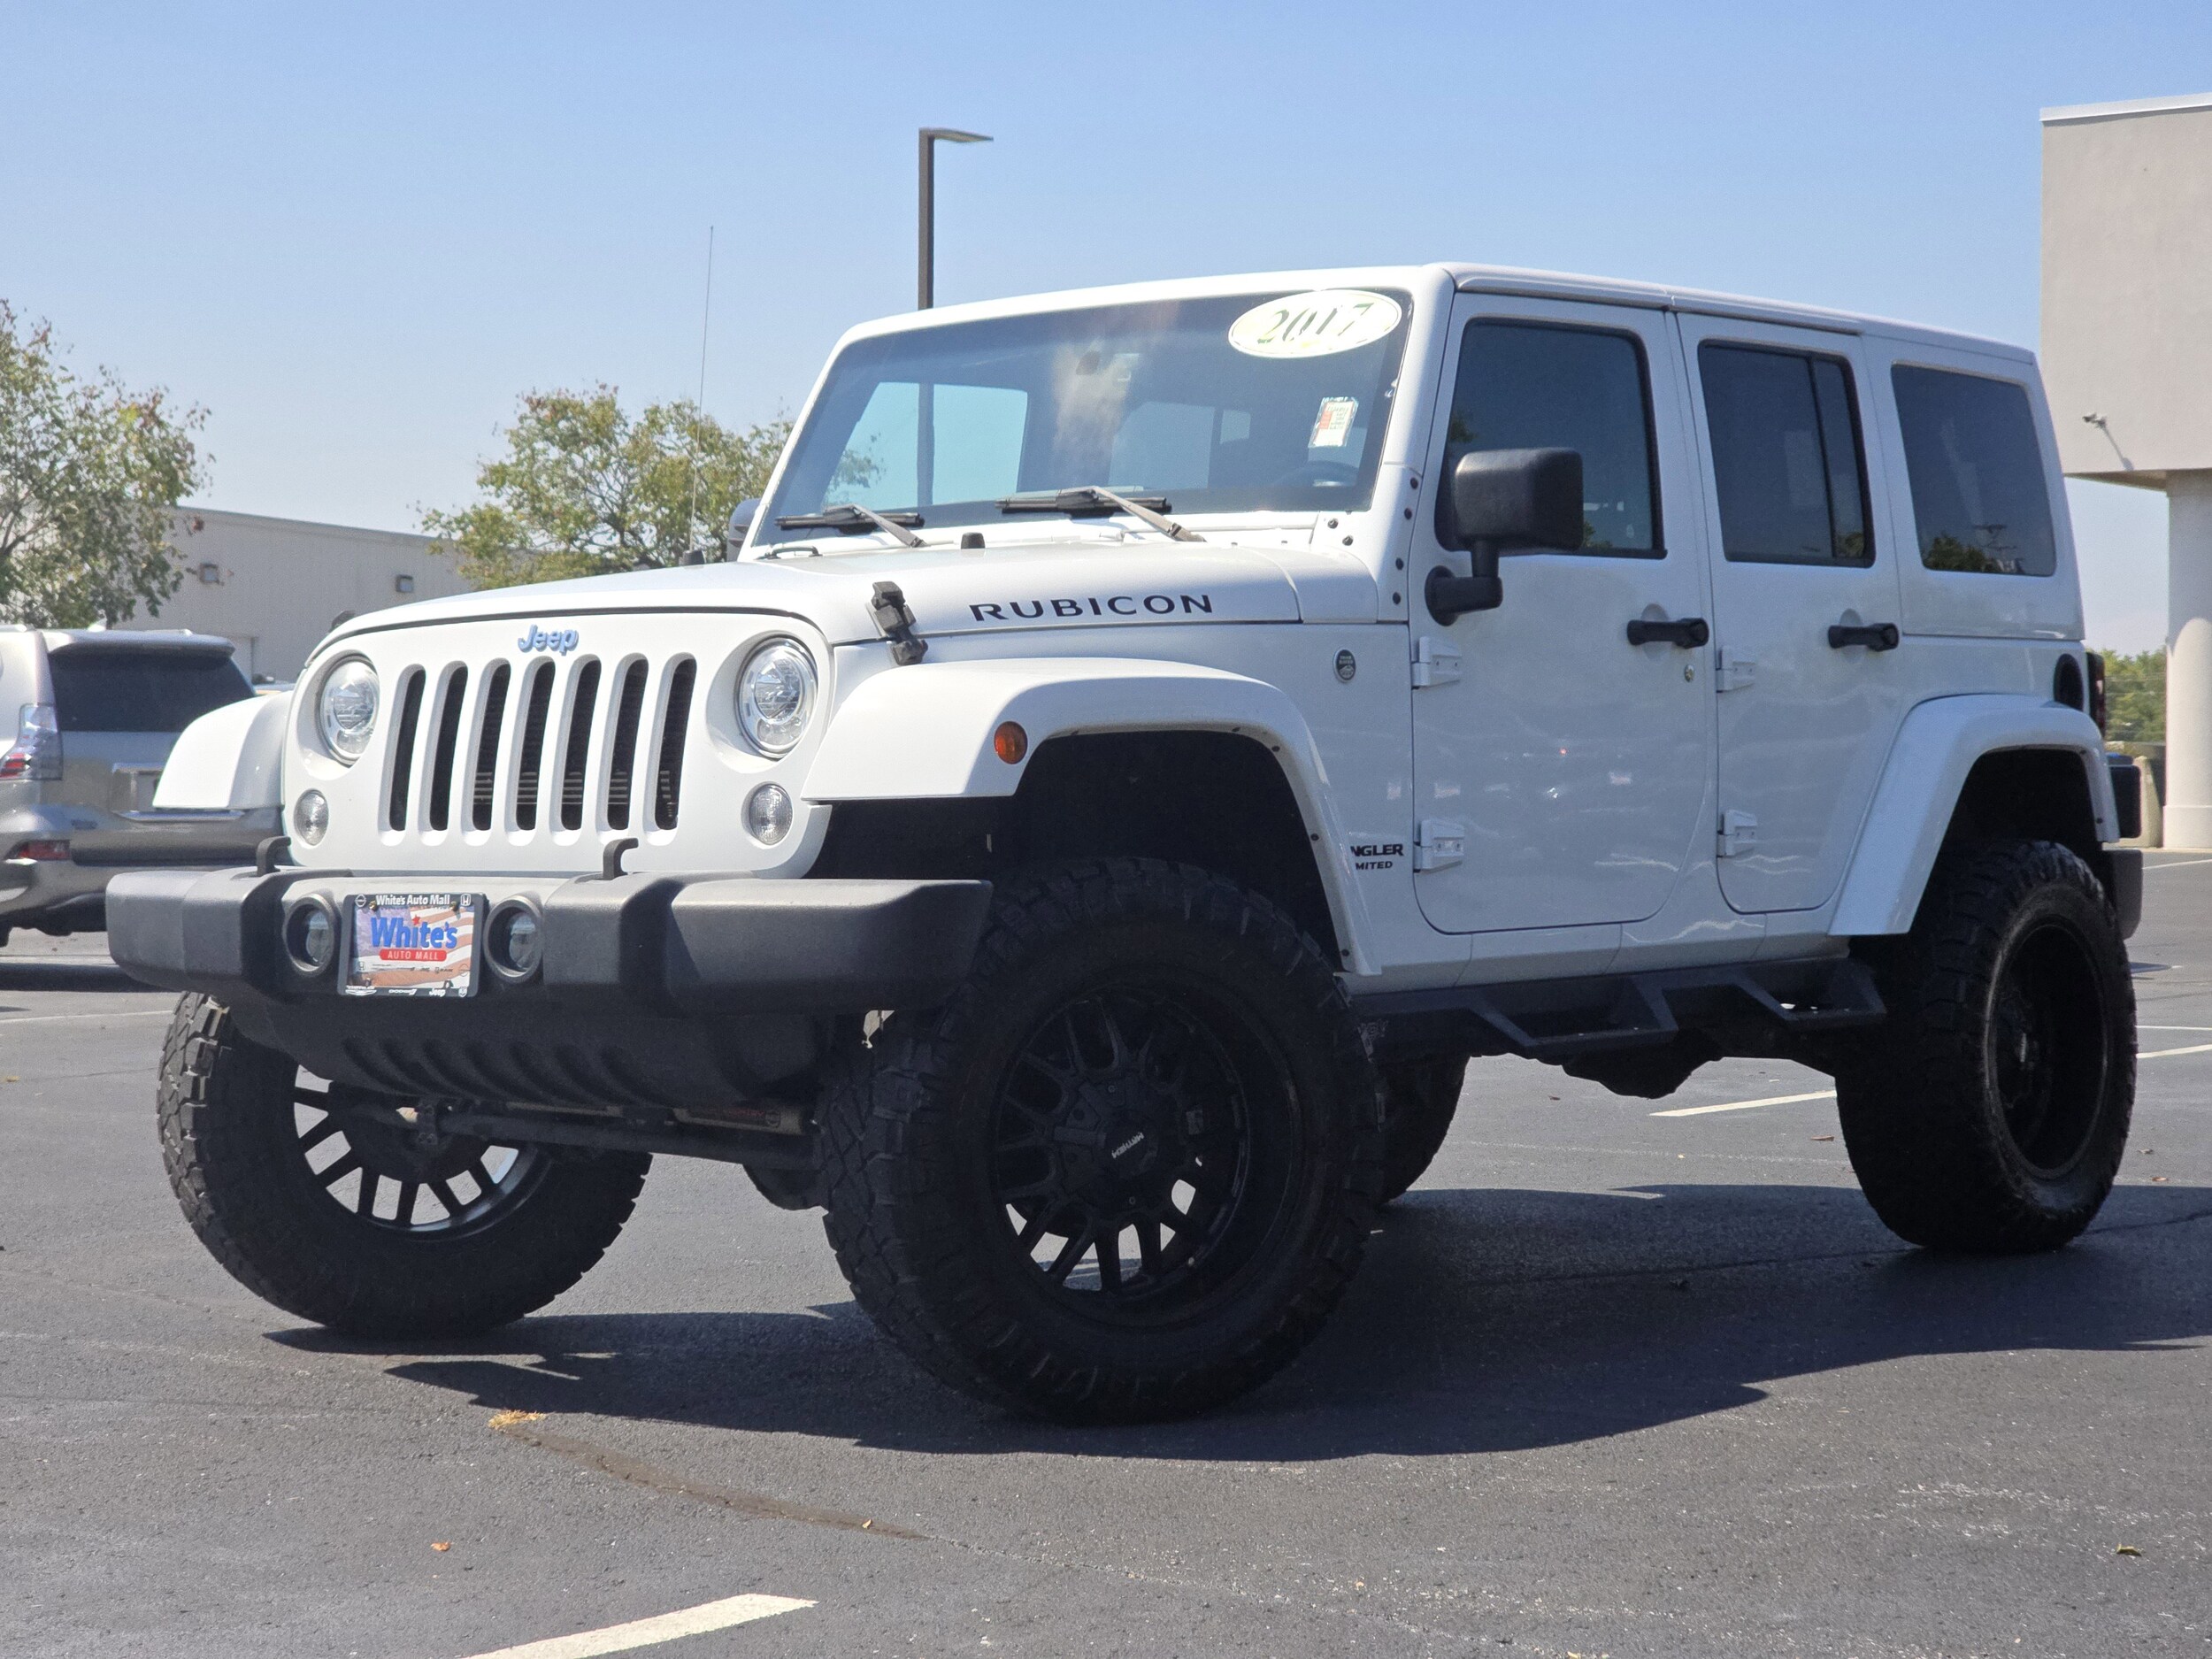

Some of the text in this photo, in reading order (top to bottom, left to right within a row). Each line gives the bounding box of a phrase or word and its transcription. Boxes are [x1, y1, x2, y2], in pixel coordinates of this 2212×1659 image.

[1256, 303, 1374, 344] 2017
[969, 595, 1213, 621] RUBICON
[518, 625, 580, 657] Jeep
[1350, 843, 1404, 856] NGLER
[1356, 861, 1394, 871] MITED
[376, 895, 450, 905] White's Auto Mall
[371, 917, 457, 949] White's
